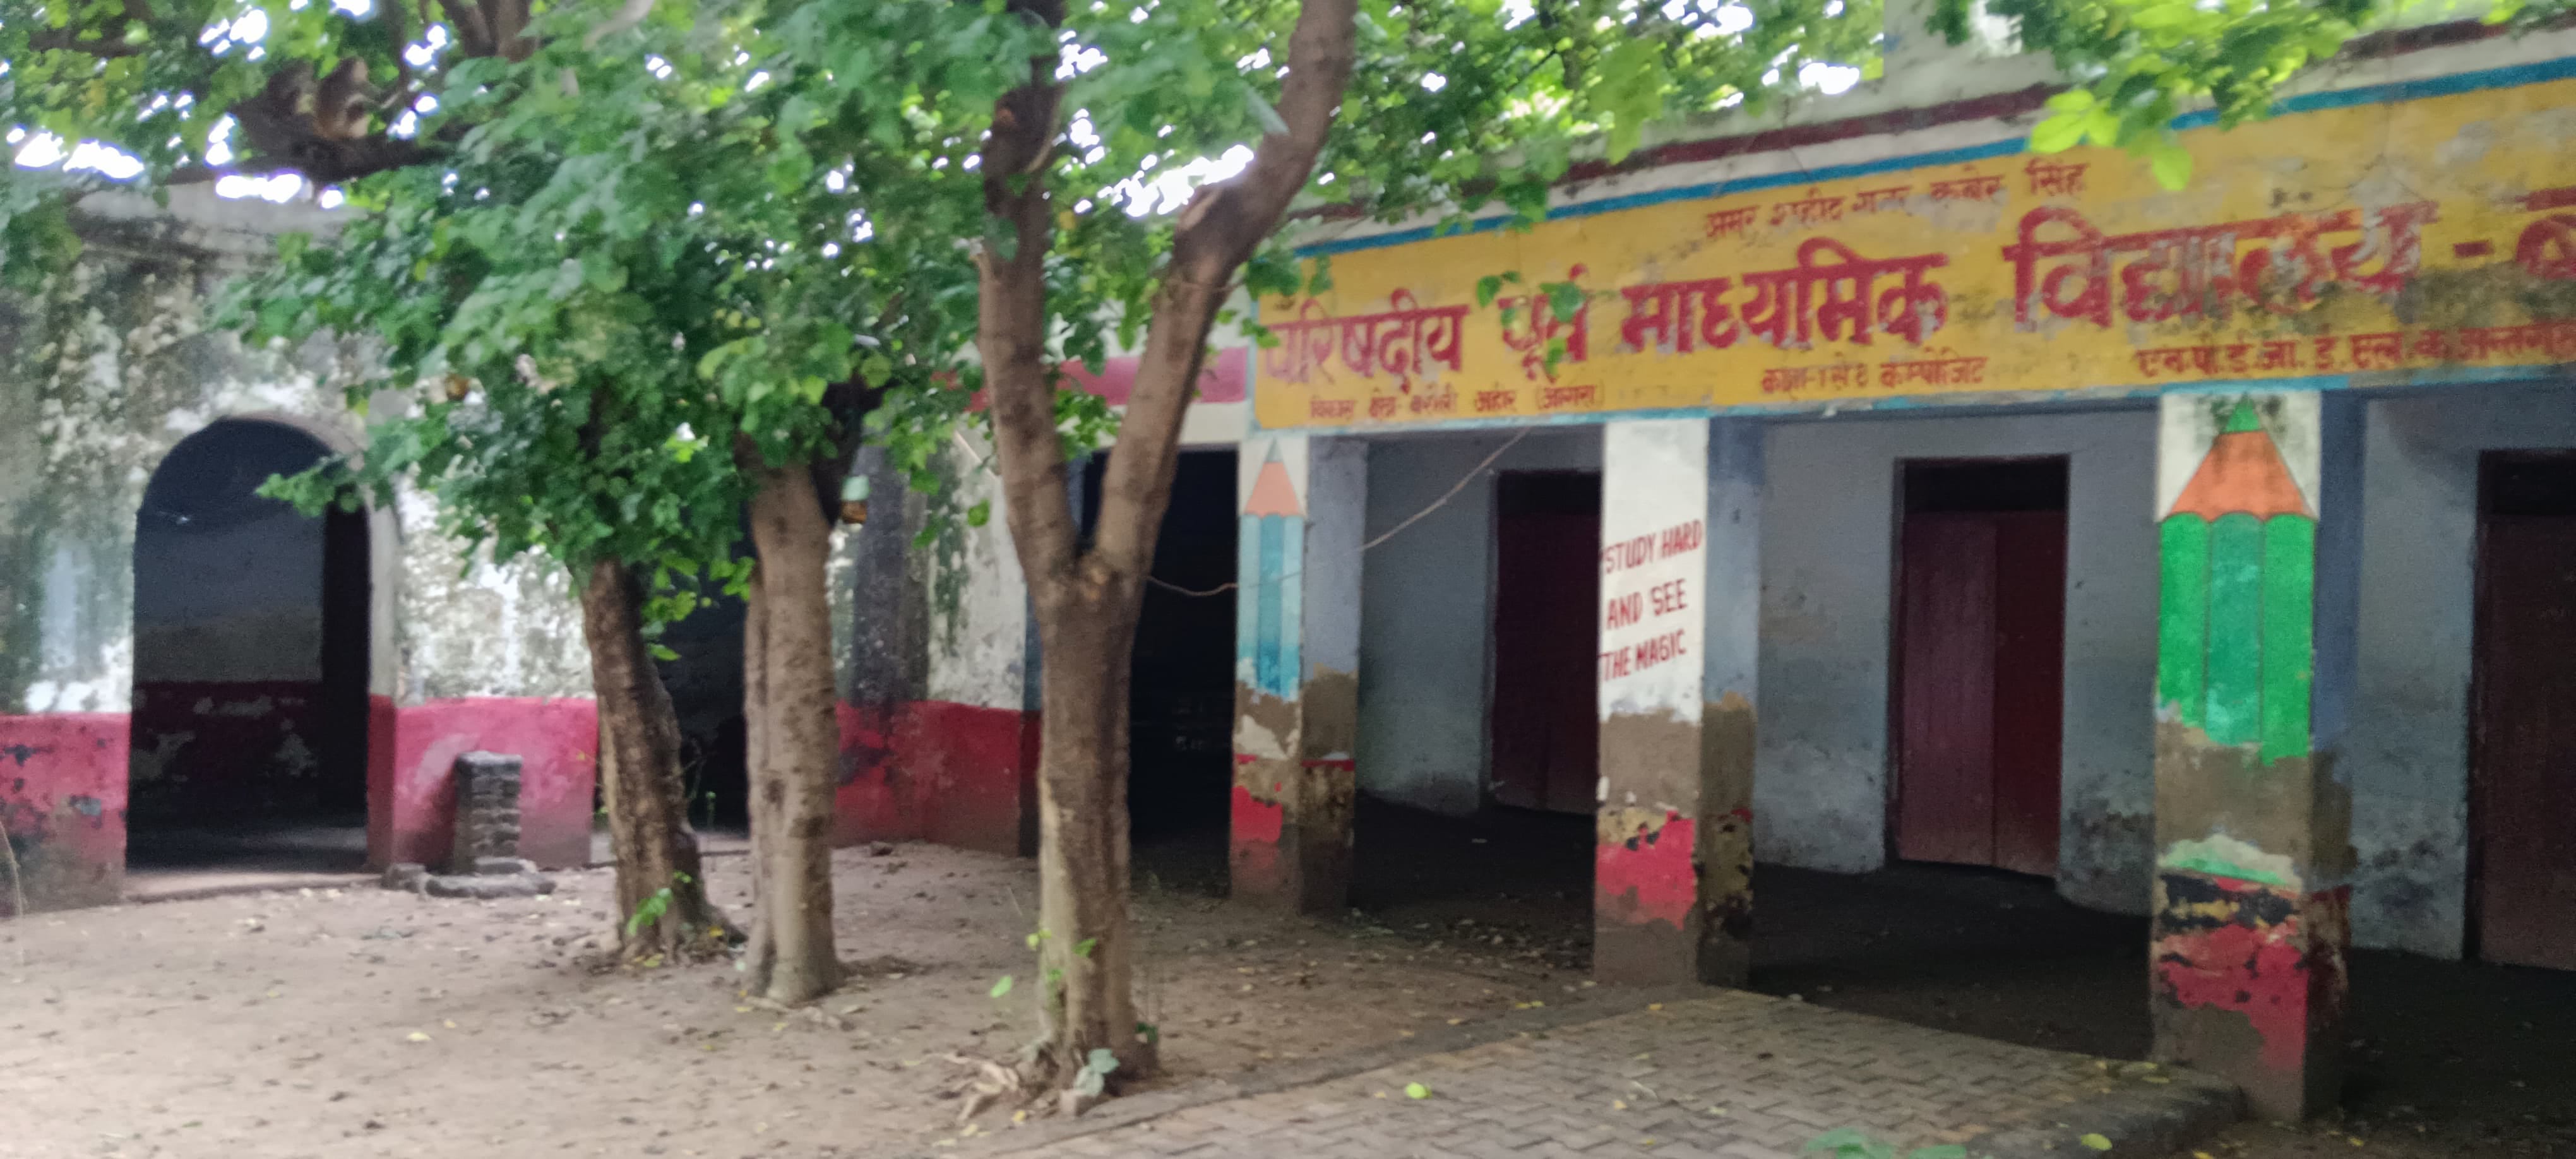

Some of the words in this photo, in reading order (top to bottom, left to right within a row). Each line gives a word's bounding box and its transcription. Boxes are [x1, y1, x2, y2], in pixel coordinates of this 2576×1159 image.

[1706, 205, 1760, 237] अमर
[2024, 158, 2090, 196] सिंह
[1264, 288, 1470, 395] परिषदीय
[1623, 237, 1948, 352] माध्यमिक
[2001, 199, 2438, 330] विद्यालय
[1604, 533, 1656, 574] STUDY
[1661, 519, 1702, 558] HARD
[1607, 591, 1643, 629] AND
[1650, 578, 1687, 617] SEE
[1599, 646, 1631, 681] THE
[1634, 629, 1687, 670] MAGIC
